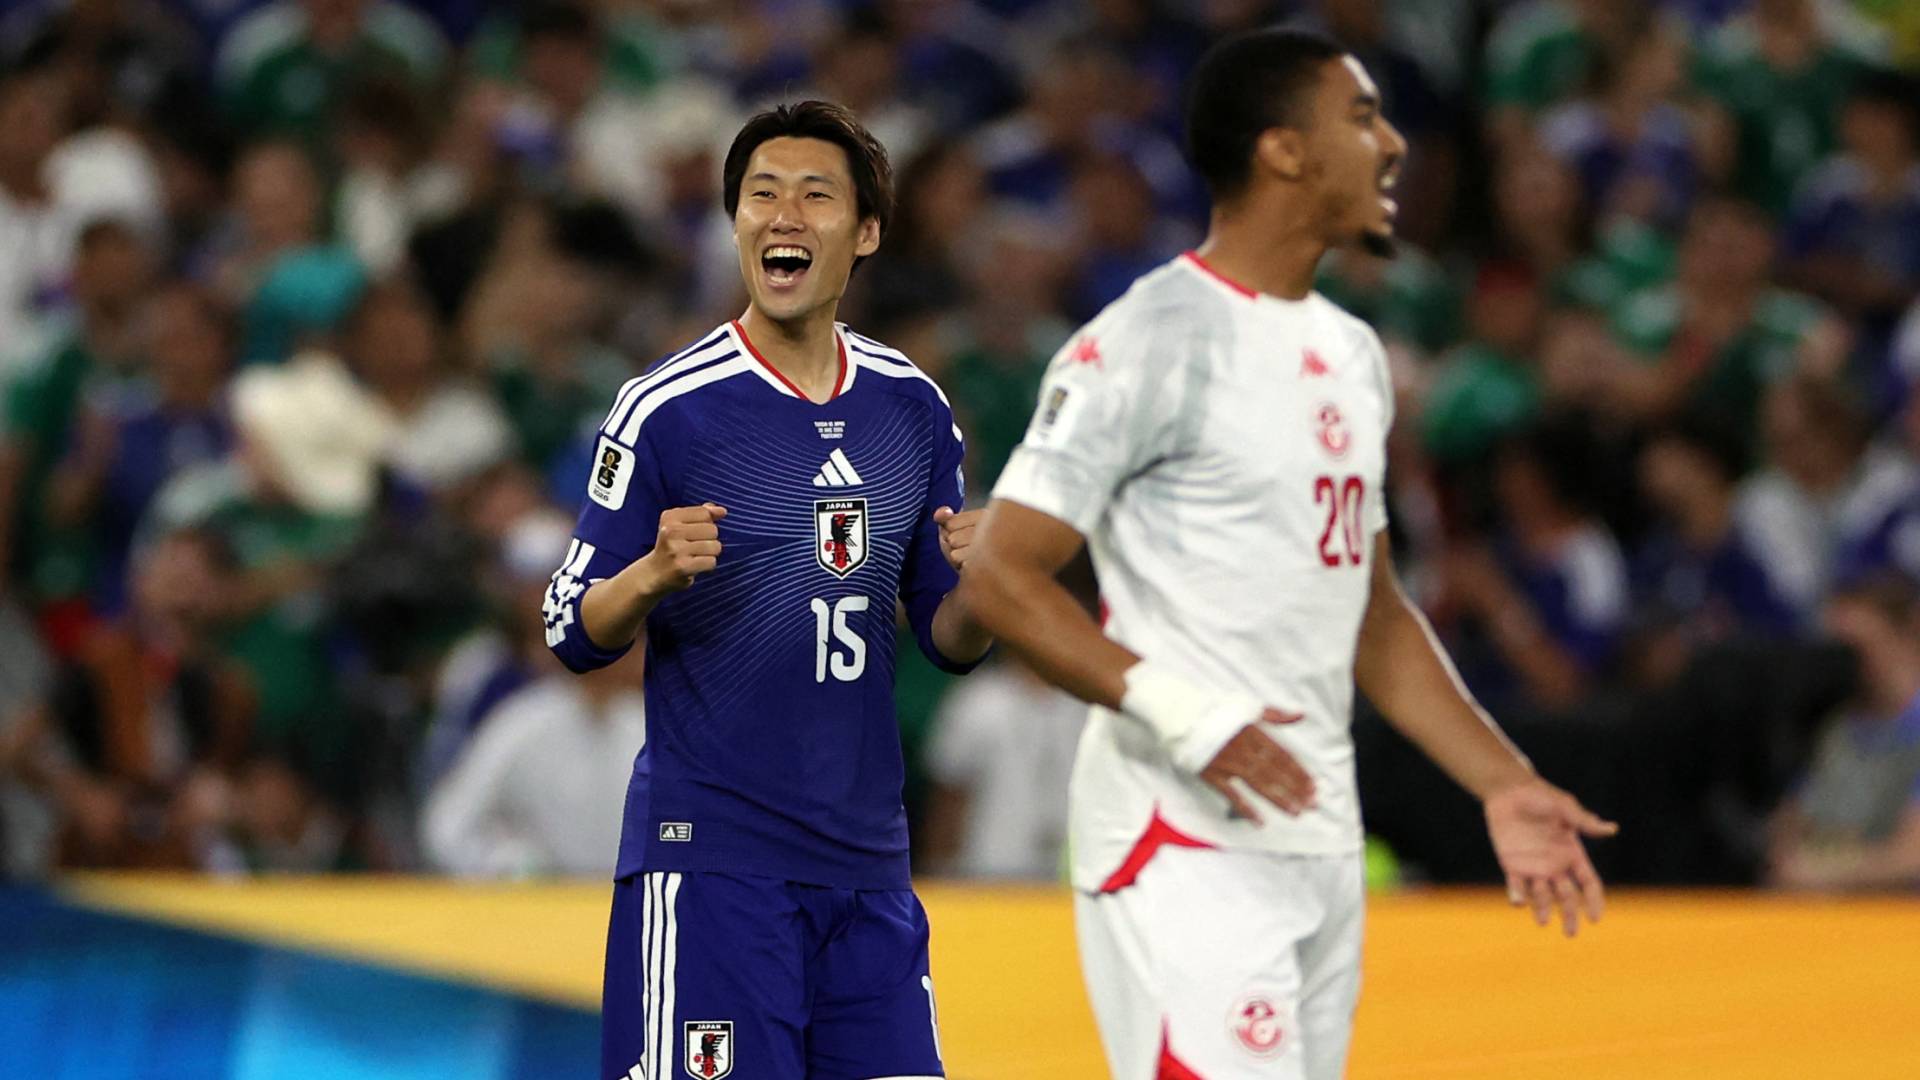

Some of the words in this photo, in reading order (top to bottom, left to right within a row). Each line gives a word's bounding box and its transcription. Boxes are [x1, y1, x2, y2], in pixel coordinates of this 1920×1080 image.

[825, 502, 853, 510] JAPAN
[1314, 475, 1362, 567] 20
[811, 596, 869, 683] 15
